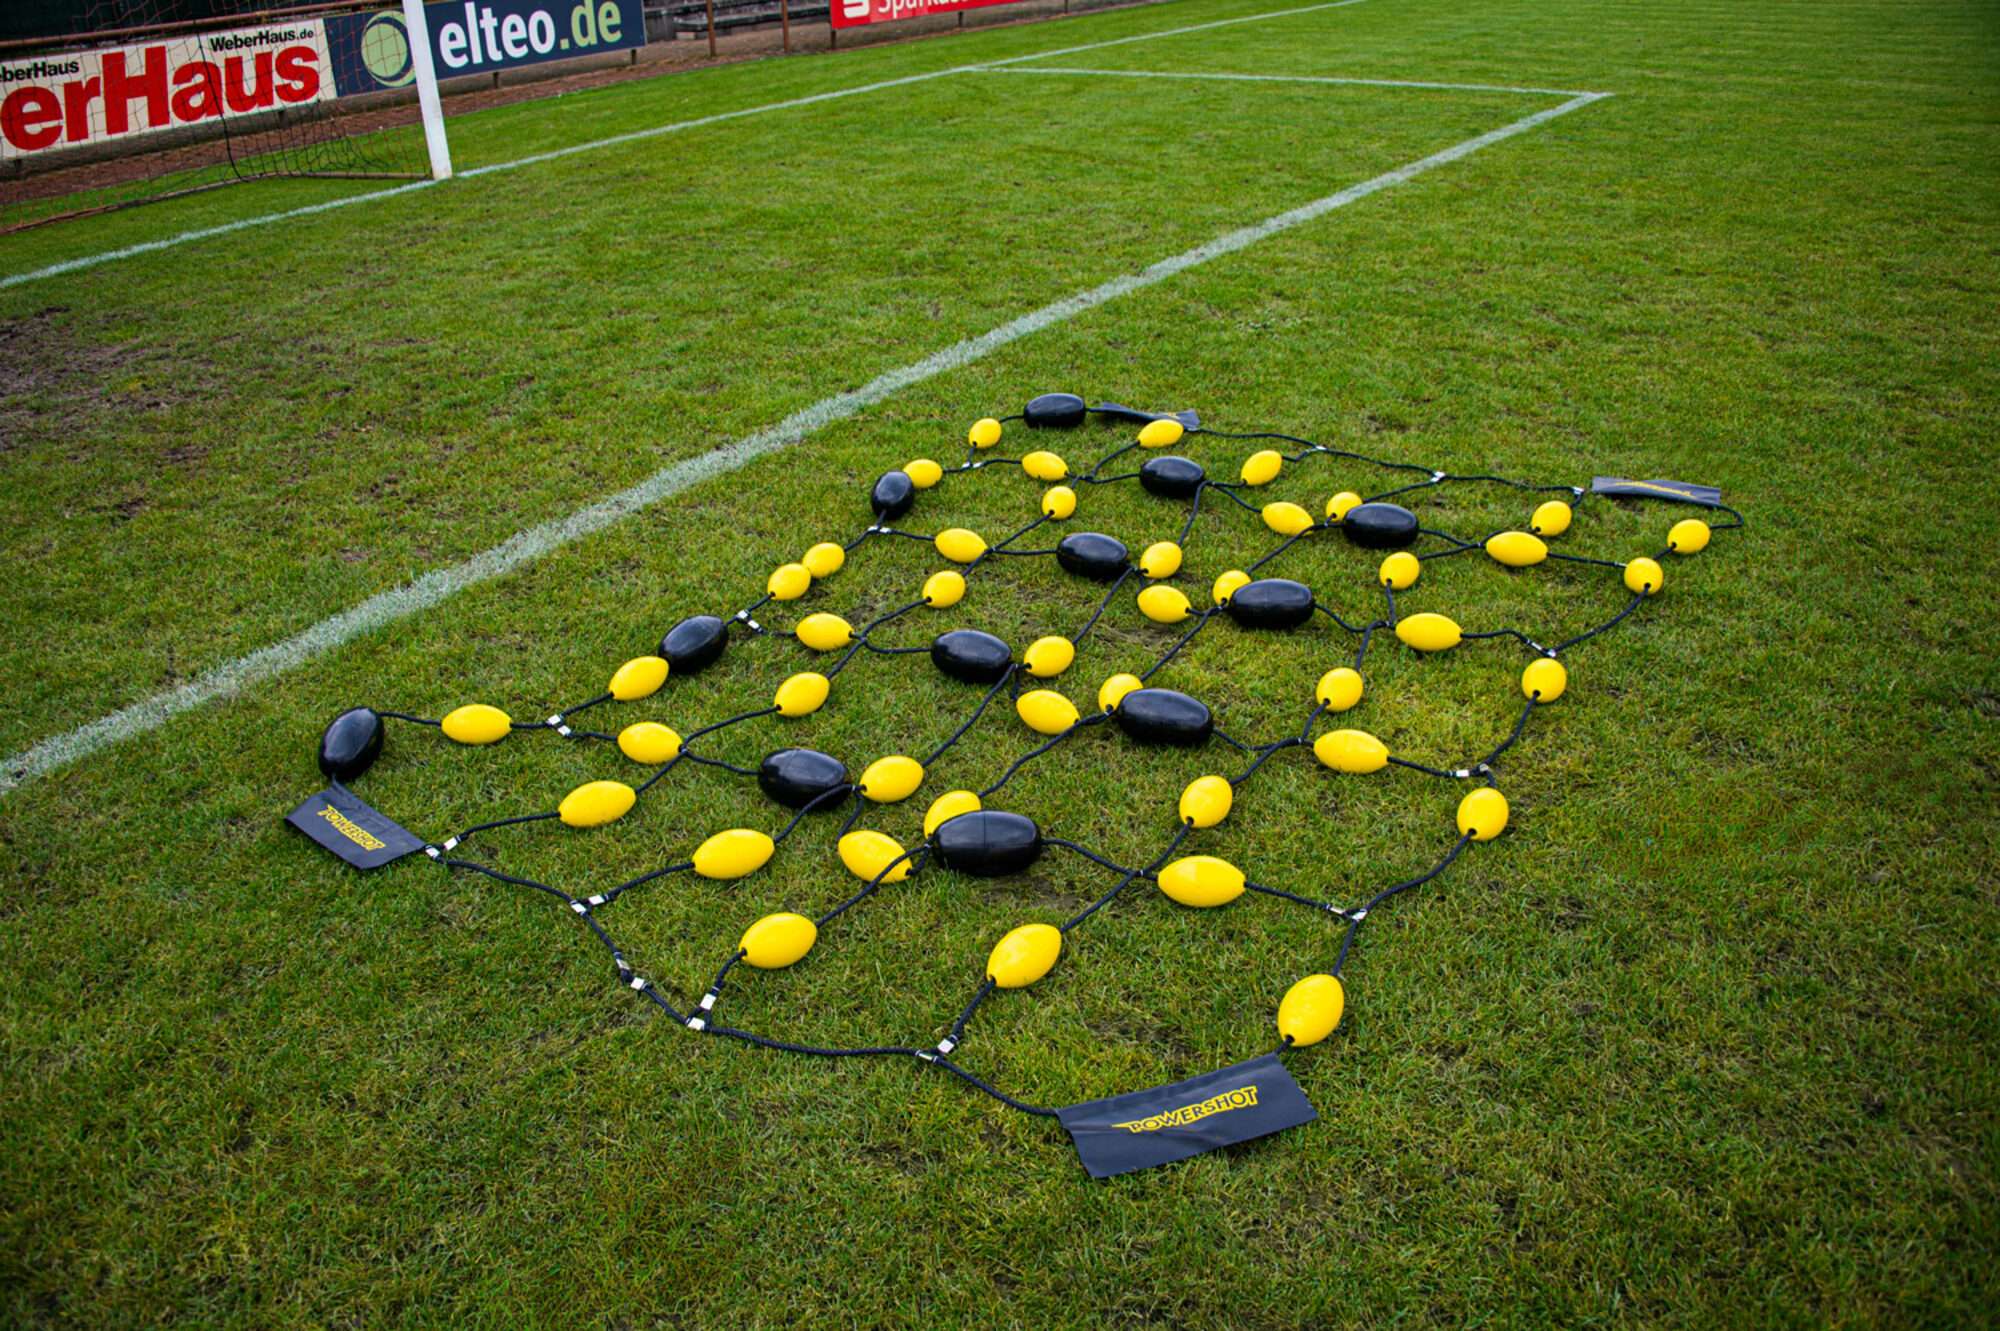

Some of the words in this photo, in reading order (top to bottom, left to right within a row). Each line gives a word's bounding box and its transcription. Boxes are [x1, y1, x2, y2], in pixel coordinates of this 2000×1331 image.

[210, 28, 314, 52] WeberHaus.de
[439, 0, 622, 68] elteo.de
[0, 61, 80, 82] berHaus
[1, 45, 320, 151] erHaus
[1125, 1085, 1258, 1133] POWERSHOT
